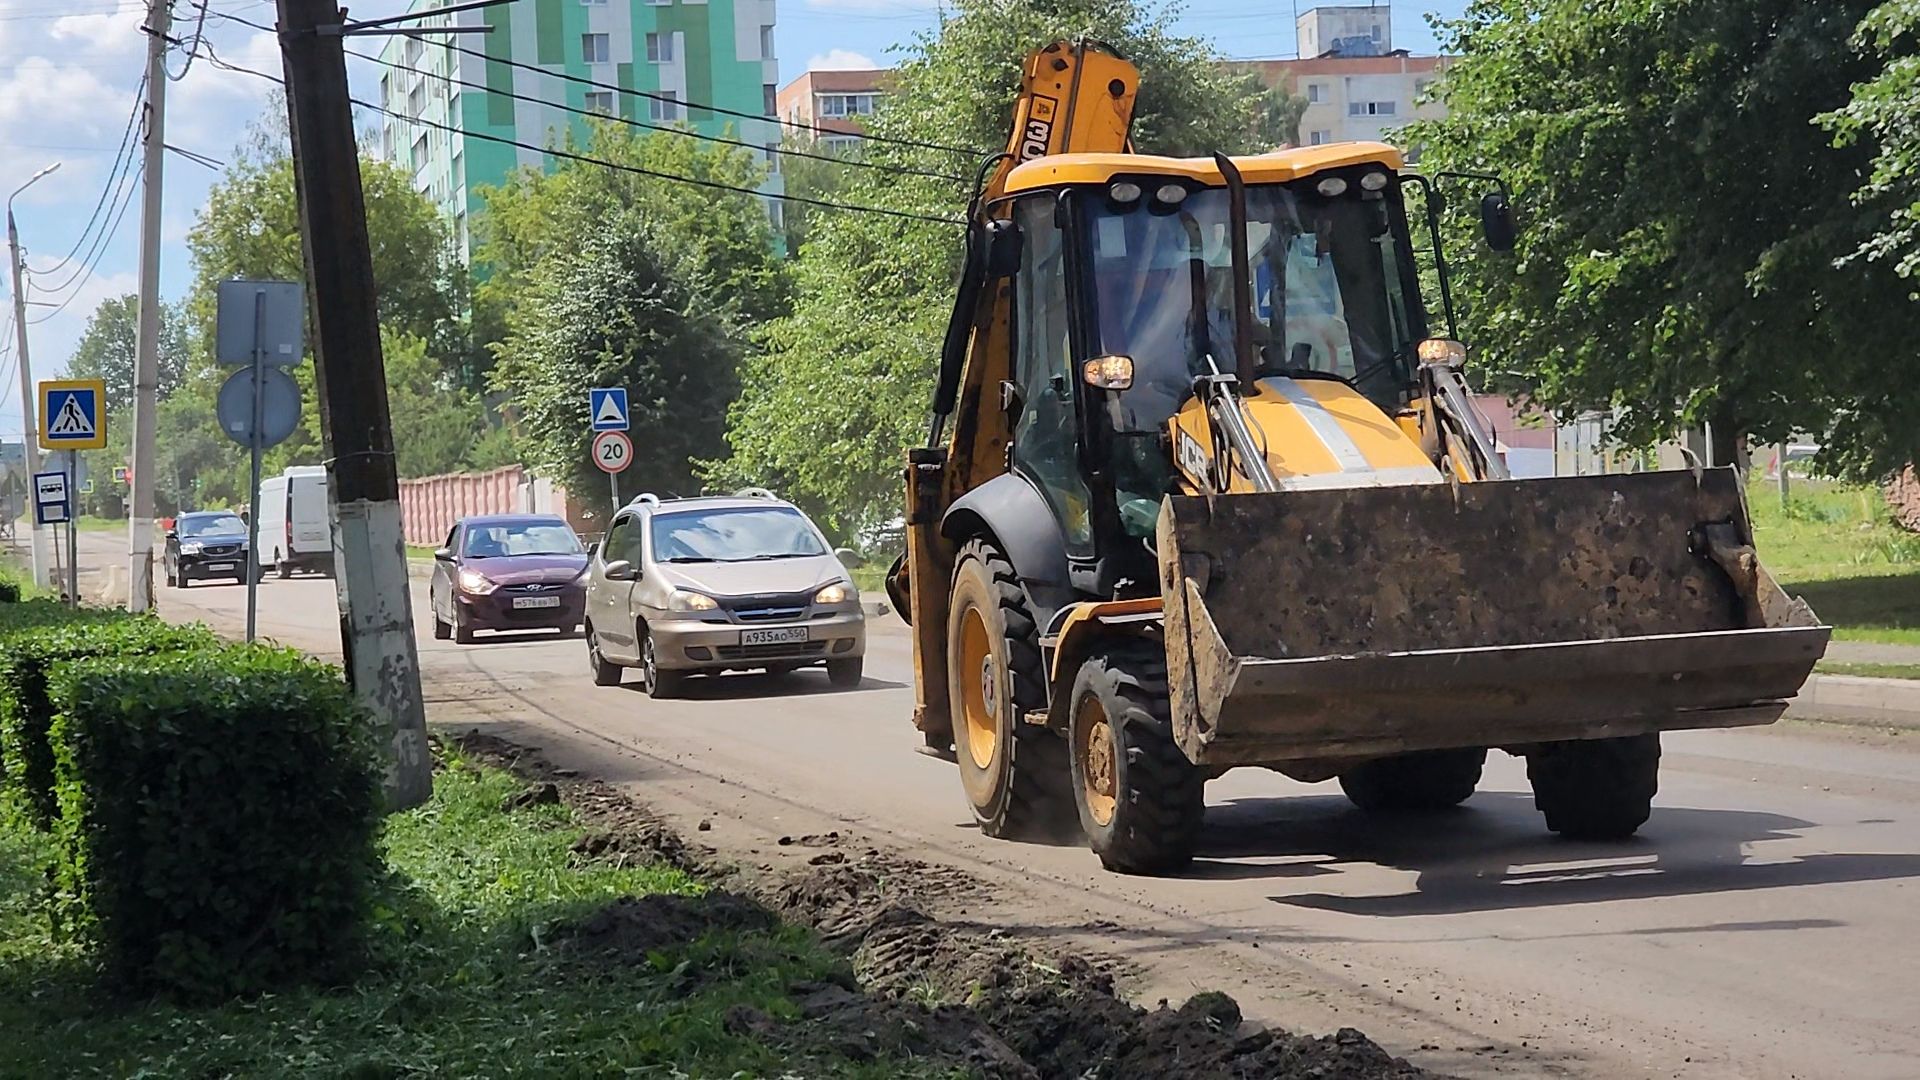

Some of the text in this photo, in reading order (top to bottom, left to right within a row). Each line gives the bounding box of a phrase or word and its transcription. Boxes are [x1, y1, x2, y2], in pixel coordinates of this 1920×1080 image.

[1021, 121, 1049, 163] 3C
[603, 444, 623, 459] 20
[1180, 431, 1206, 478] JCB
